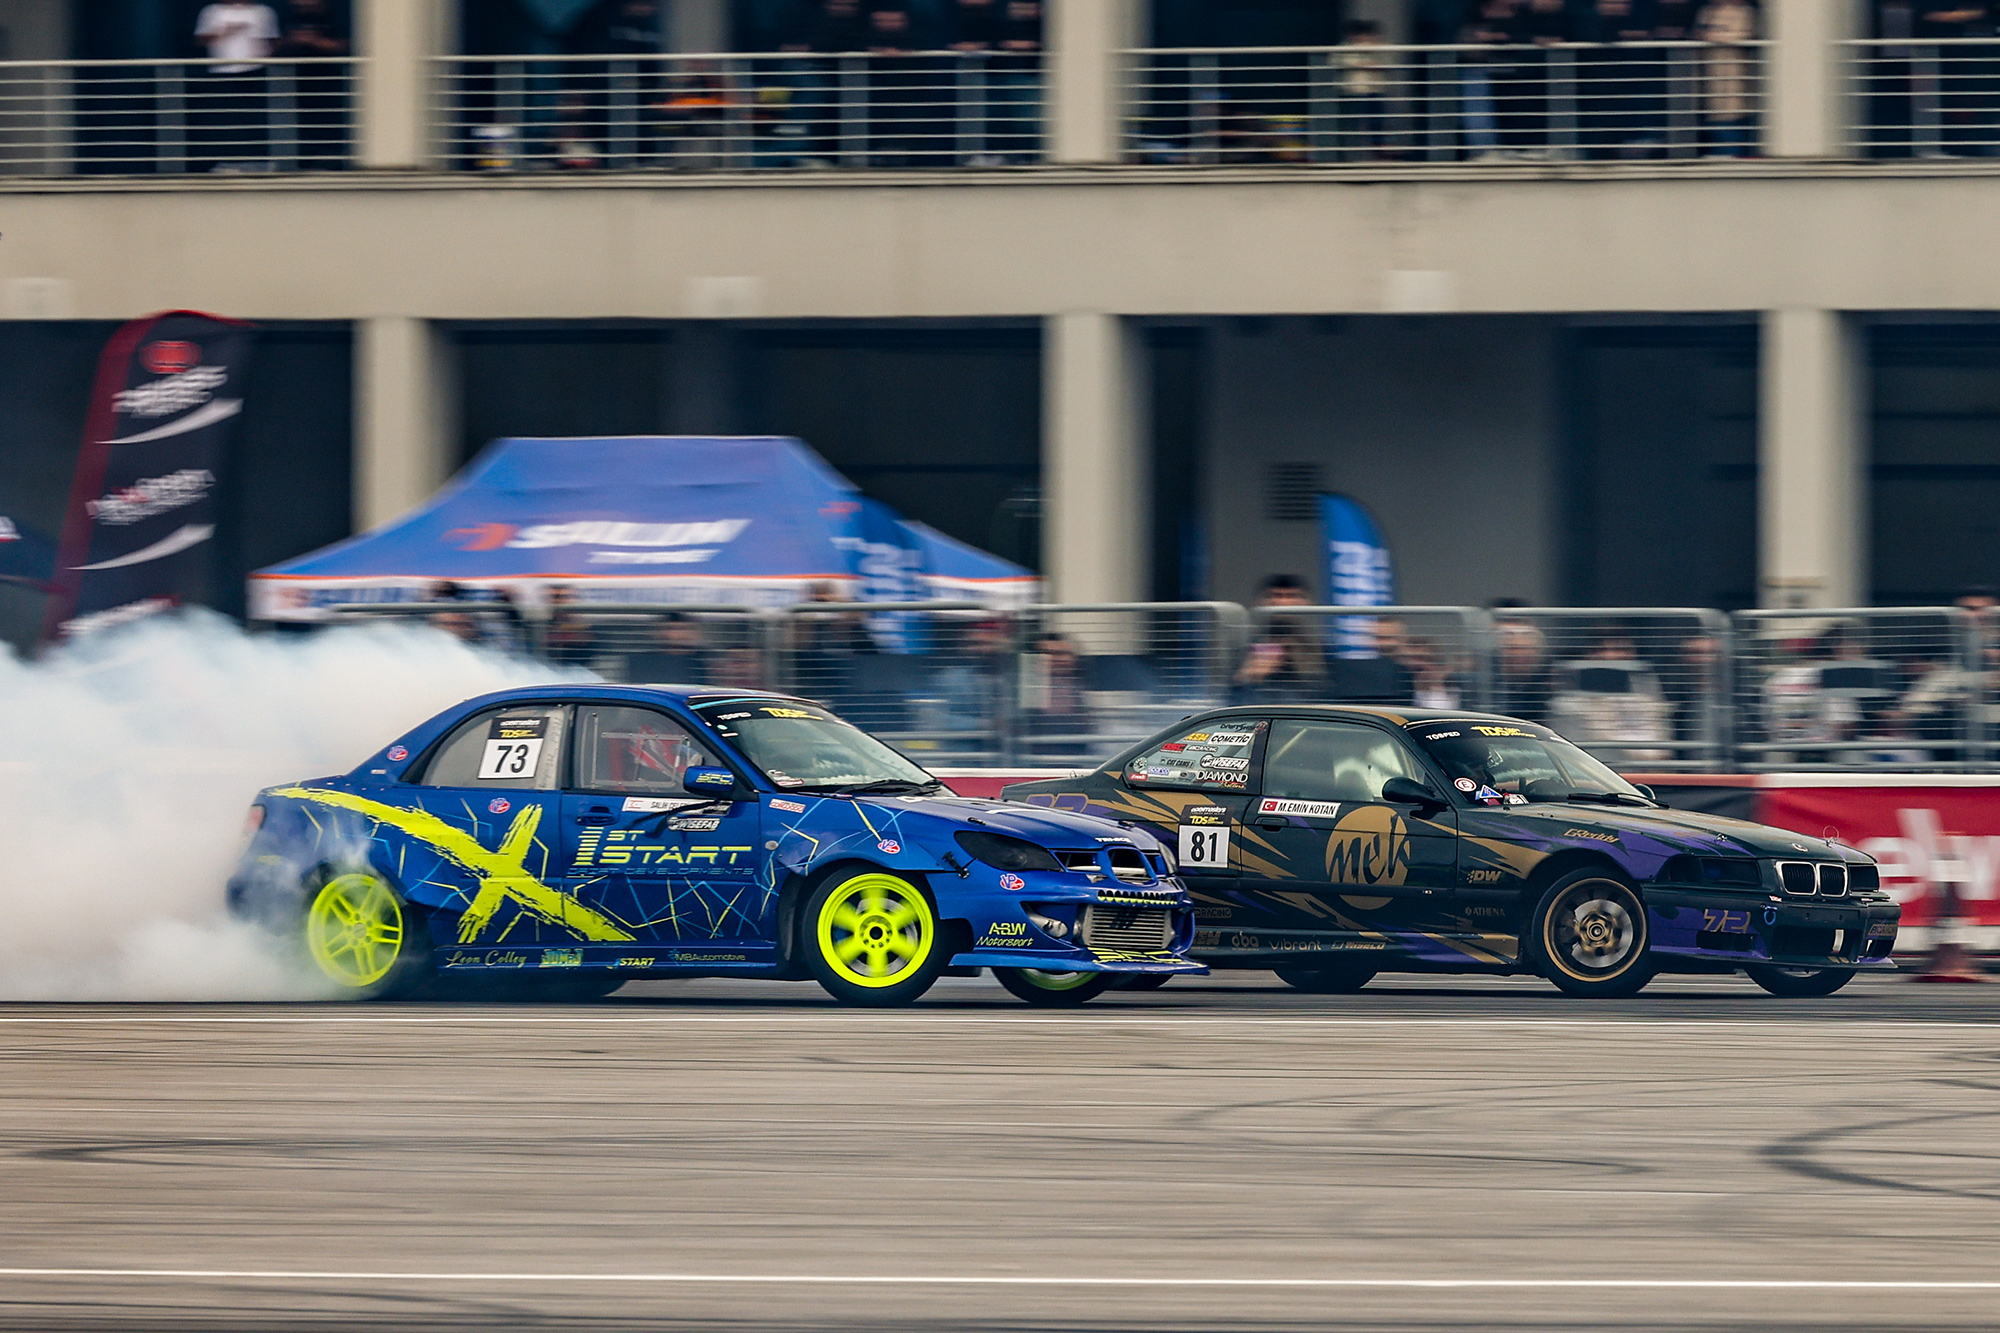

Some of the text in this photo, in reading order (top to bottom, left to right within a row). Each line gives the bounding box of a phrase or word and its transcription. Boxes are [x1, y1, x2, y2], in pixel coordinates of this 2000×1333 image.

[494, 744, 530, 773] 73
[1212, 758, 1247, 769] WISEFAB
[1196, 770, 1249, 783] DIAMOND
[1309, 803, 1335, 815] KOTAN
[679, 819, 720, 829] WISEFAB
[1189, 815, 1209, 825] TDS
[1190, 831, 1218, 862] 81
[599, 845, 752, 865] START
[624, 867, 754, 876] DEVELOPMENTS
[1474, 870, 1502, 882] DW
[1201, 908, 1232, 918] RACING
[1472, 906, 1506, 917] ATHENA
[975, 935, 1034, 947] Motorsport
[1269, 939, 1322, 951] vibrant
[445, 950, 481, 967] Leon
[484, 949, 527, 969] Colley
[619, 957, 656, 967] START
